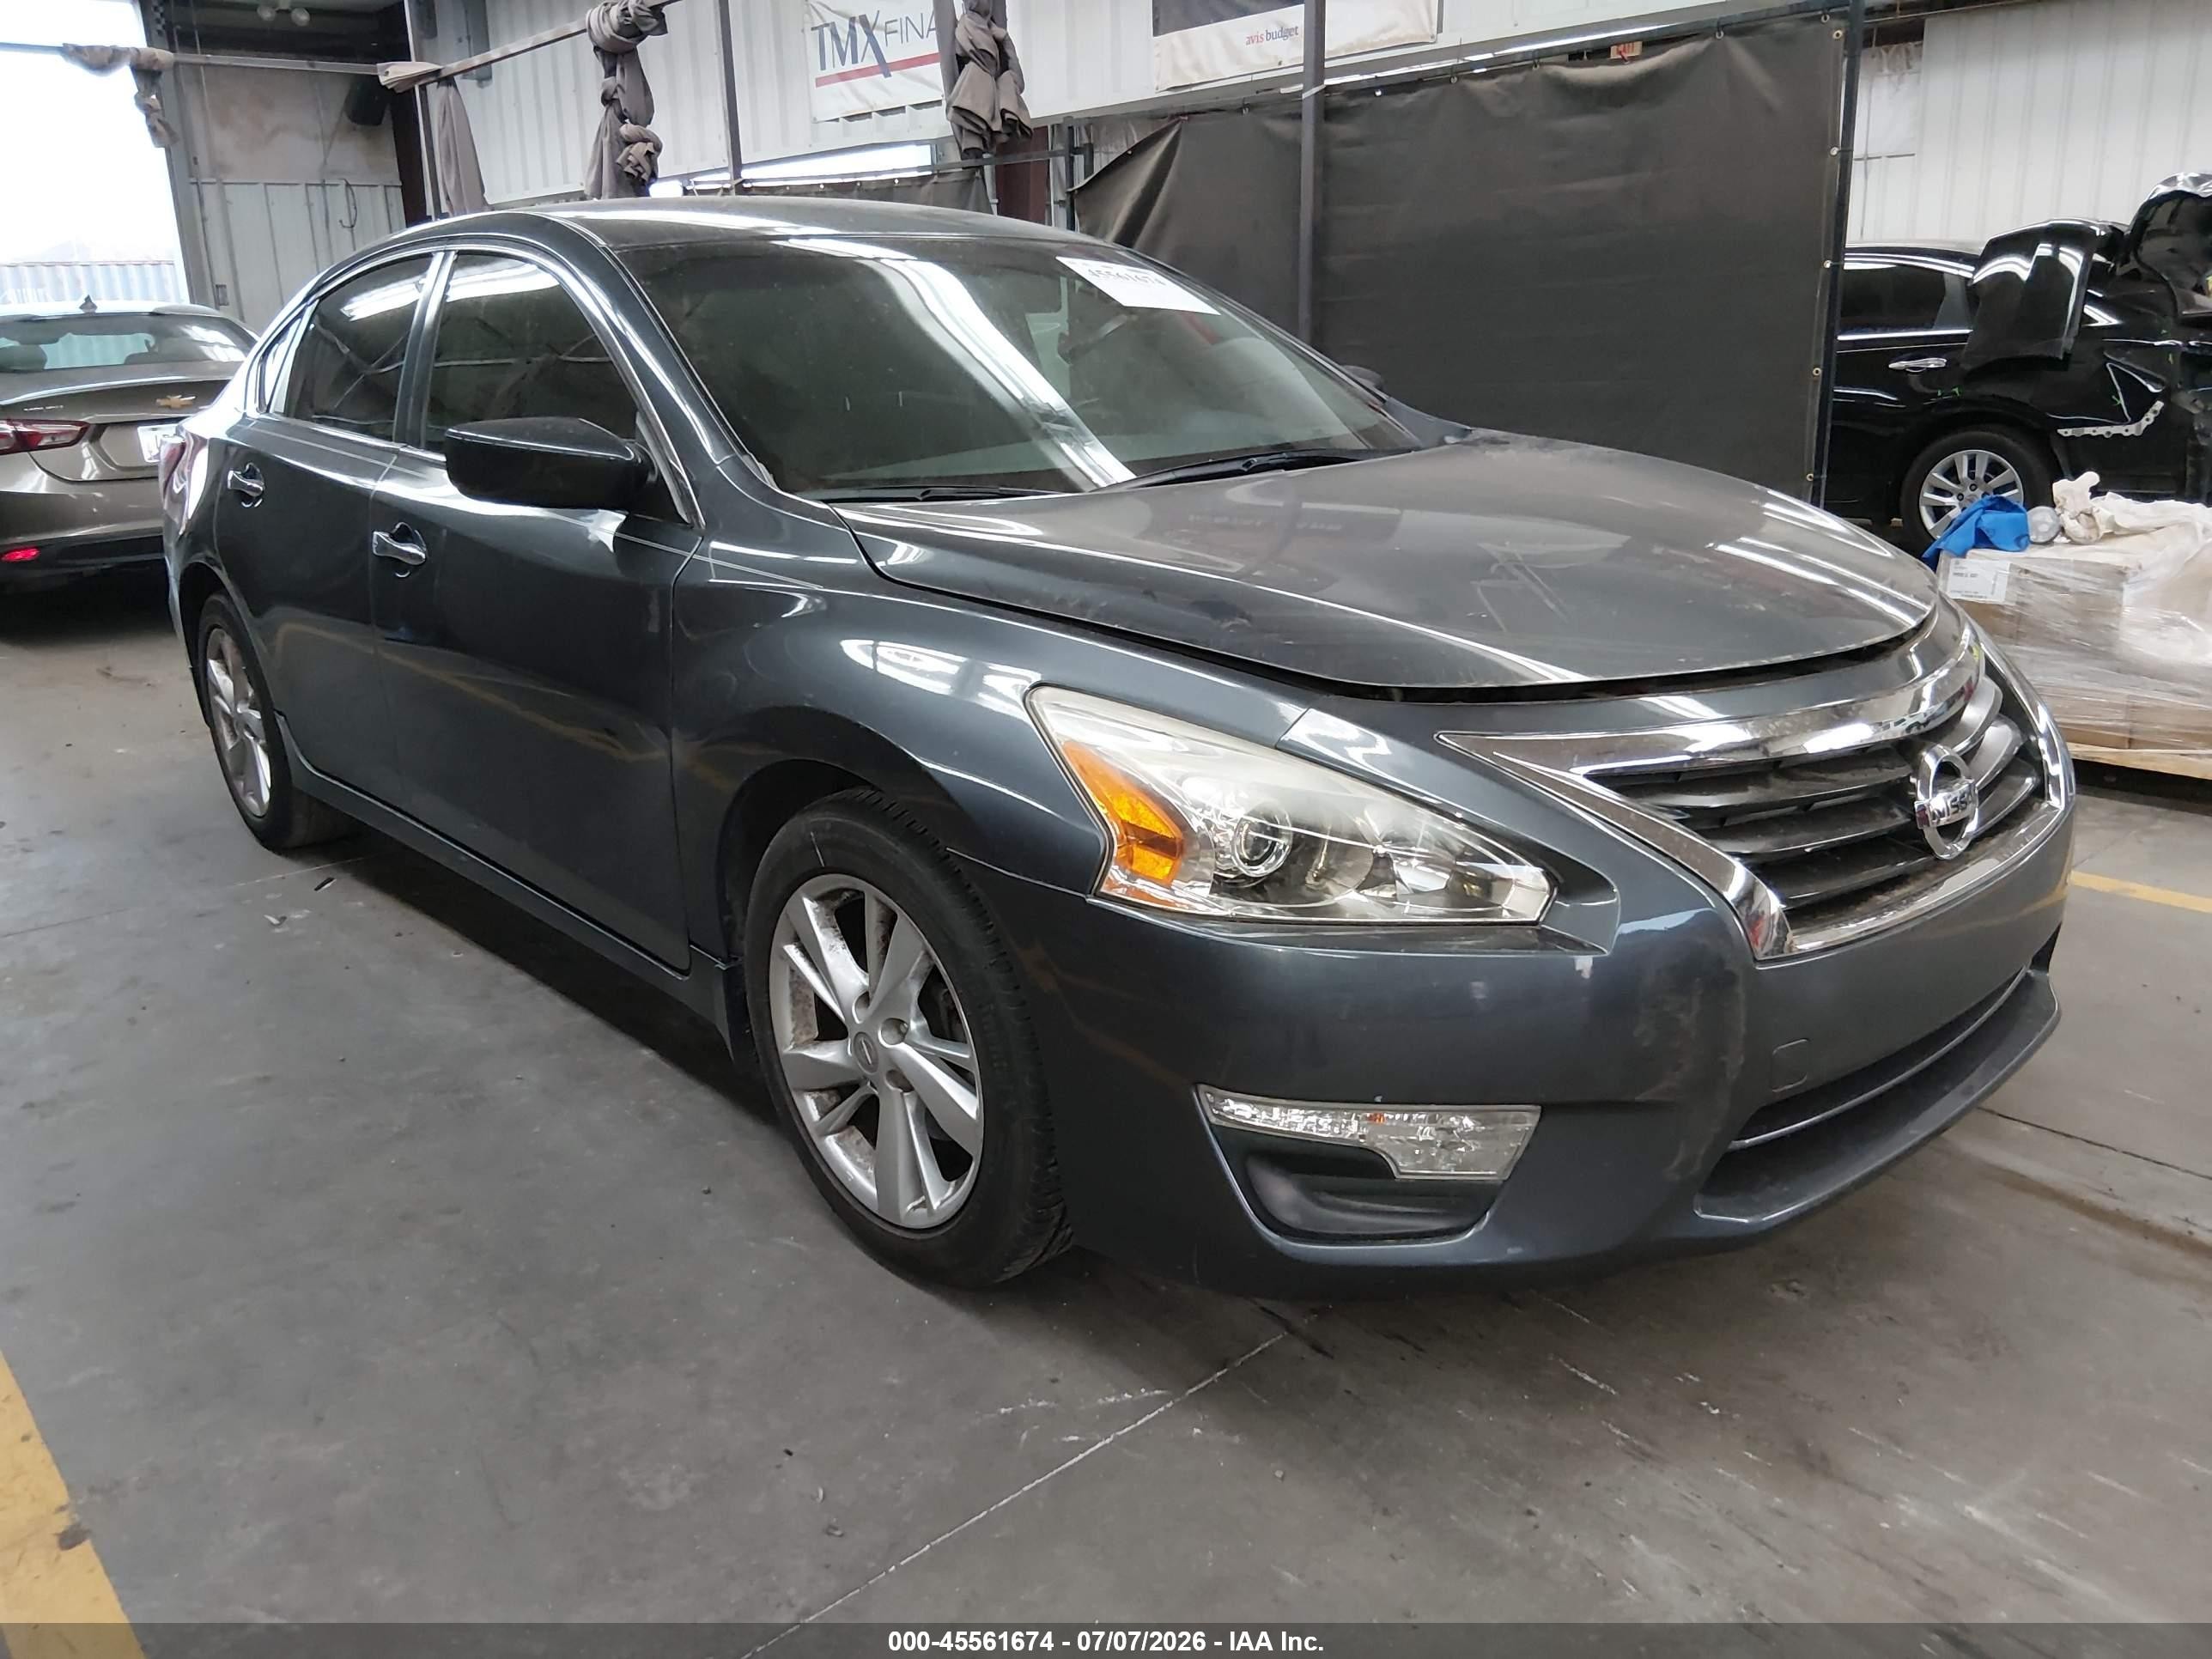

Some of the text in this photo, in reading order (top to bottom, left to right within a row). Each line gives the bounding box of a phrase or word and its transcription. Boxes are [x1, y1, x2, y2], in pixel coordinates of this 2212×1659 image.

[811, 10, 892, 78] TMX
[1245, 26, 1298, 46] avis budget
